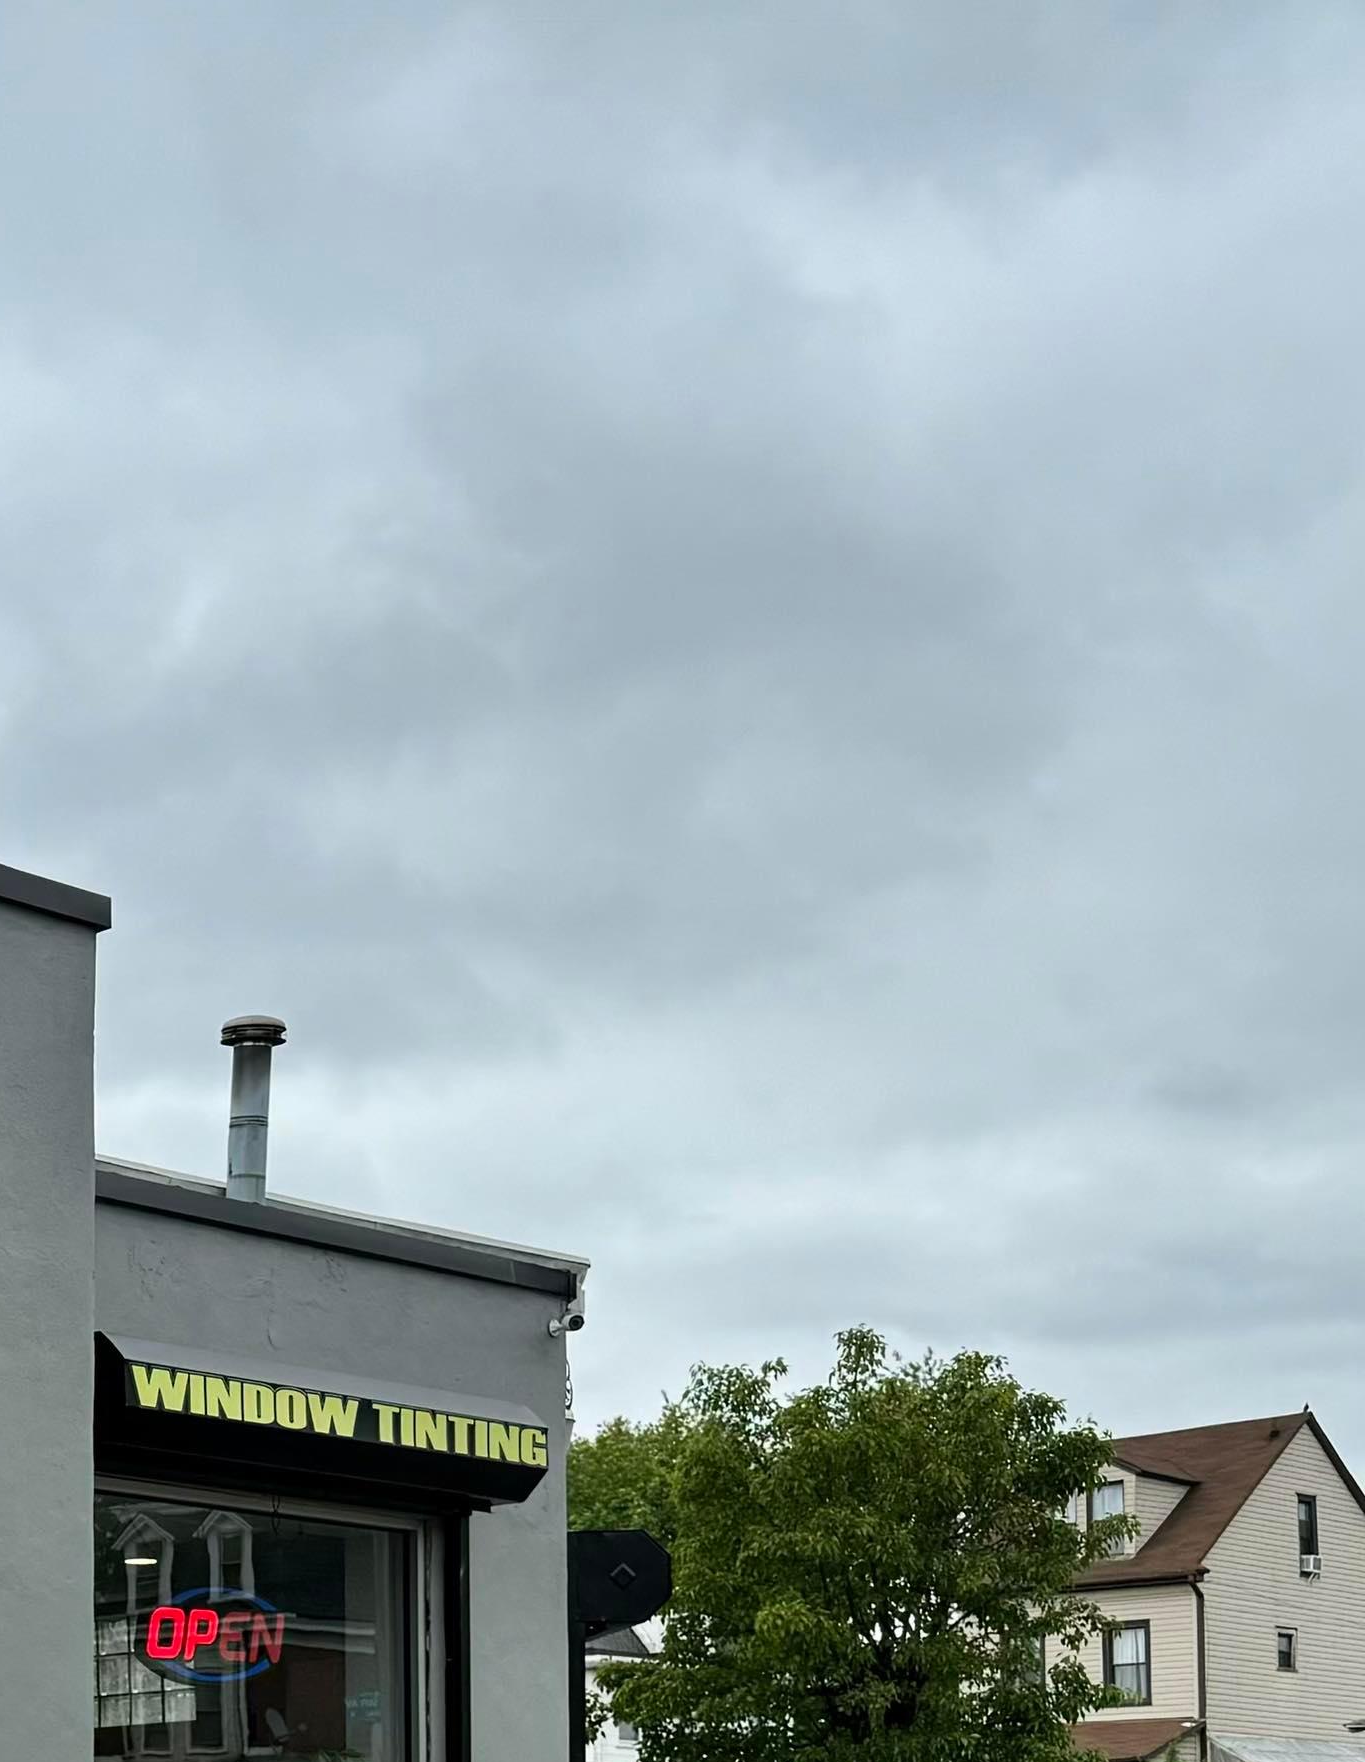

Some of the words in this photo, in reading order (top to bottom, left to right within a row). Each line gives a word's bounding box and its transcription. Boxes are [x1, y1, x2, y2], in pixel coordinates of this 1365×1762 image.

[131, 1363, 359, 1438] WINDOW
[373, 1403, 548, 1467] TINTING
[146, 1606, 285, 1664] OPEN
